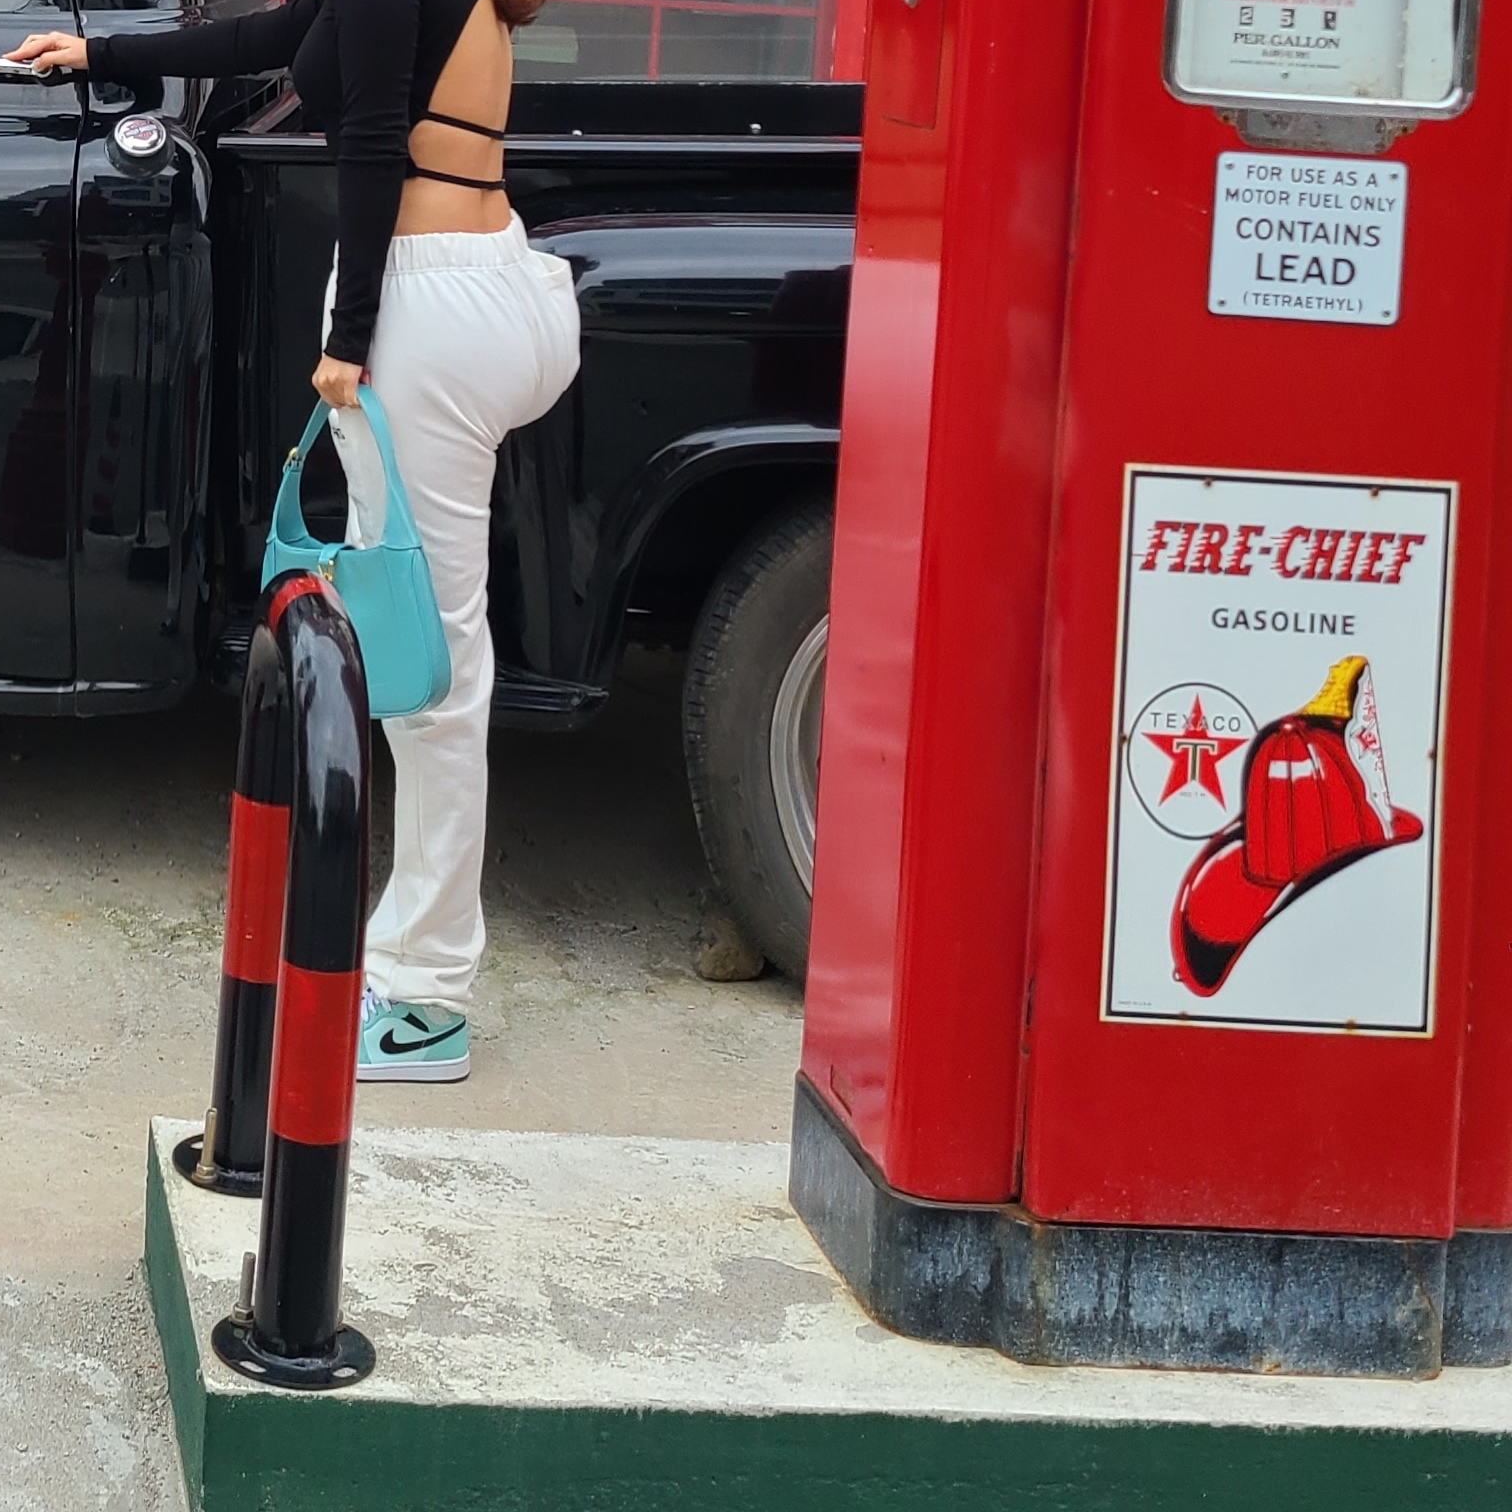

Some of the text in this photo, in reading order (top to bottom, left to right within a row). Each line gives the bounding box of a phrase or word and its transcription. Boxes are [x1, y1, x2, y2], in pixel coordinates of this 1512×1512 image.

[1233, 32, 1341, 49] PER GALLON
[1246, 164, 1379, 188] FOR USE AS A
[1224, 187, 1397, 213] MOTOR FUEL ONLY
[1235, 216, 1381, 248] CONTAINS
[1255, 252, 1356, 286] LEAD
[1243, 290, 1364, 313] (TETRAETHYL)
[1135, 519, 1426, 585] FIRE-CHIEF
[1210, 606, 1356, 637] GASOLINE
[1149, 711, 1242, 733] TEXACO
